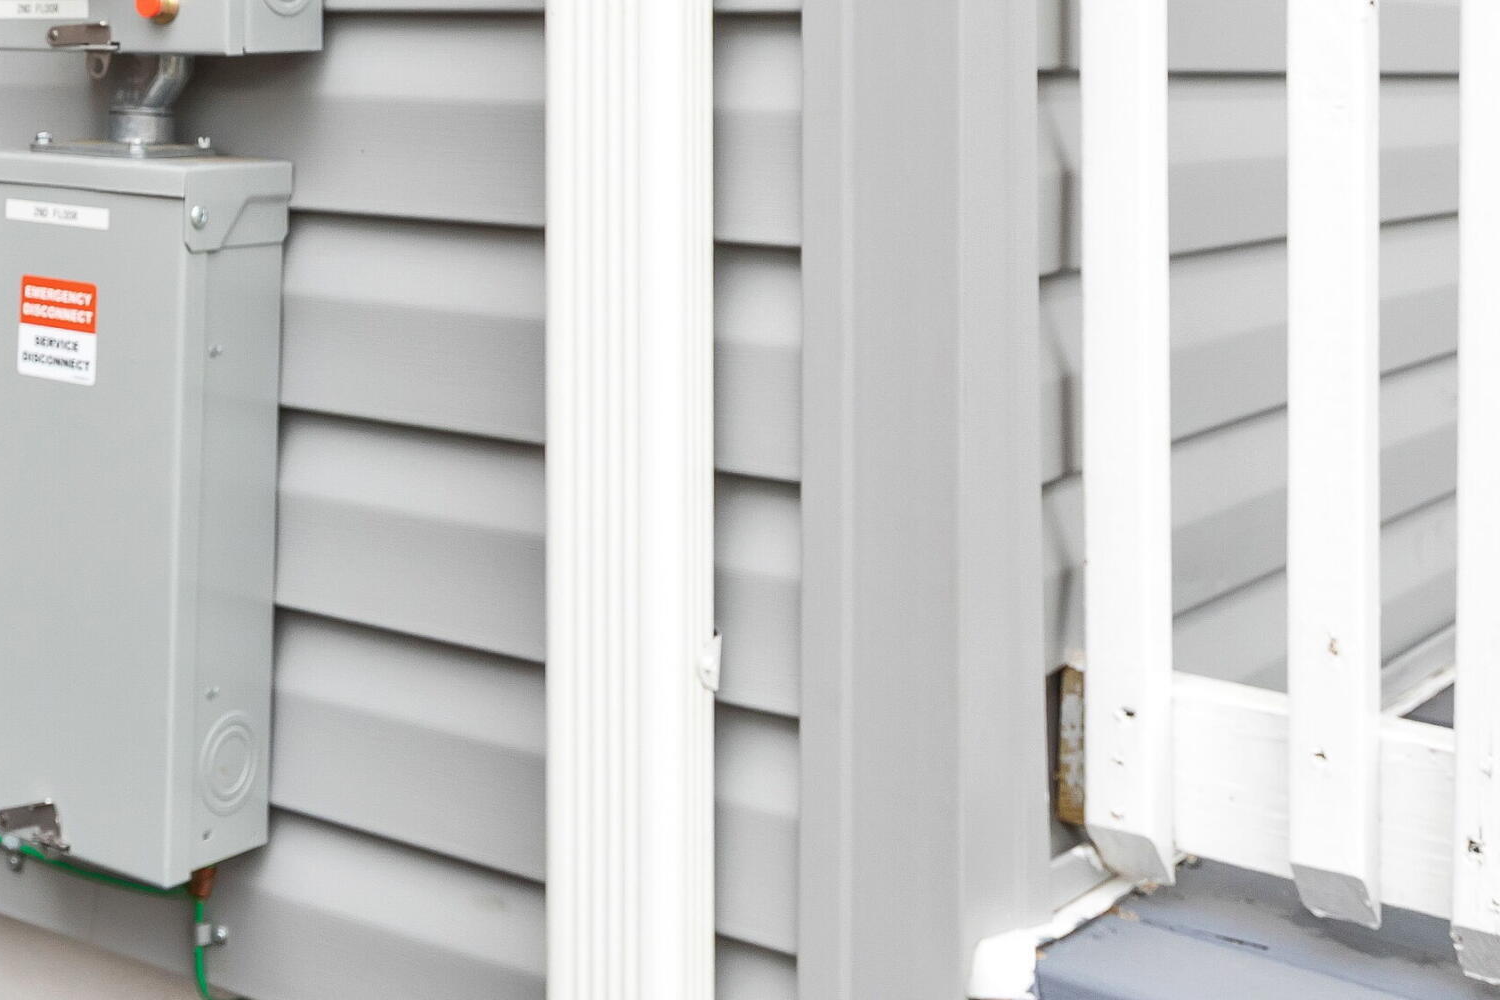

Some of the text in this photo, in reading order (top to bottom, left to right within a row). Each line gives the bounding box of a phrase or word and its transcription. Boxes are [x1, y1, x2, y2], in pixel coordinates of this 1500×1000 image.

[24, 285, 93, 306] EMERGENCY
[22, 302, 94, 324] DISCONNECT
[35, 335, 79, 352] SERVICE
[22, 351, 90, 370] DISCONNECT
